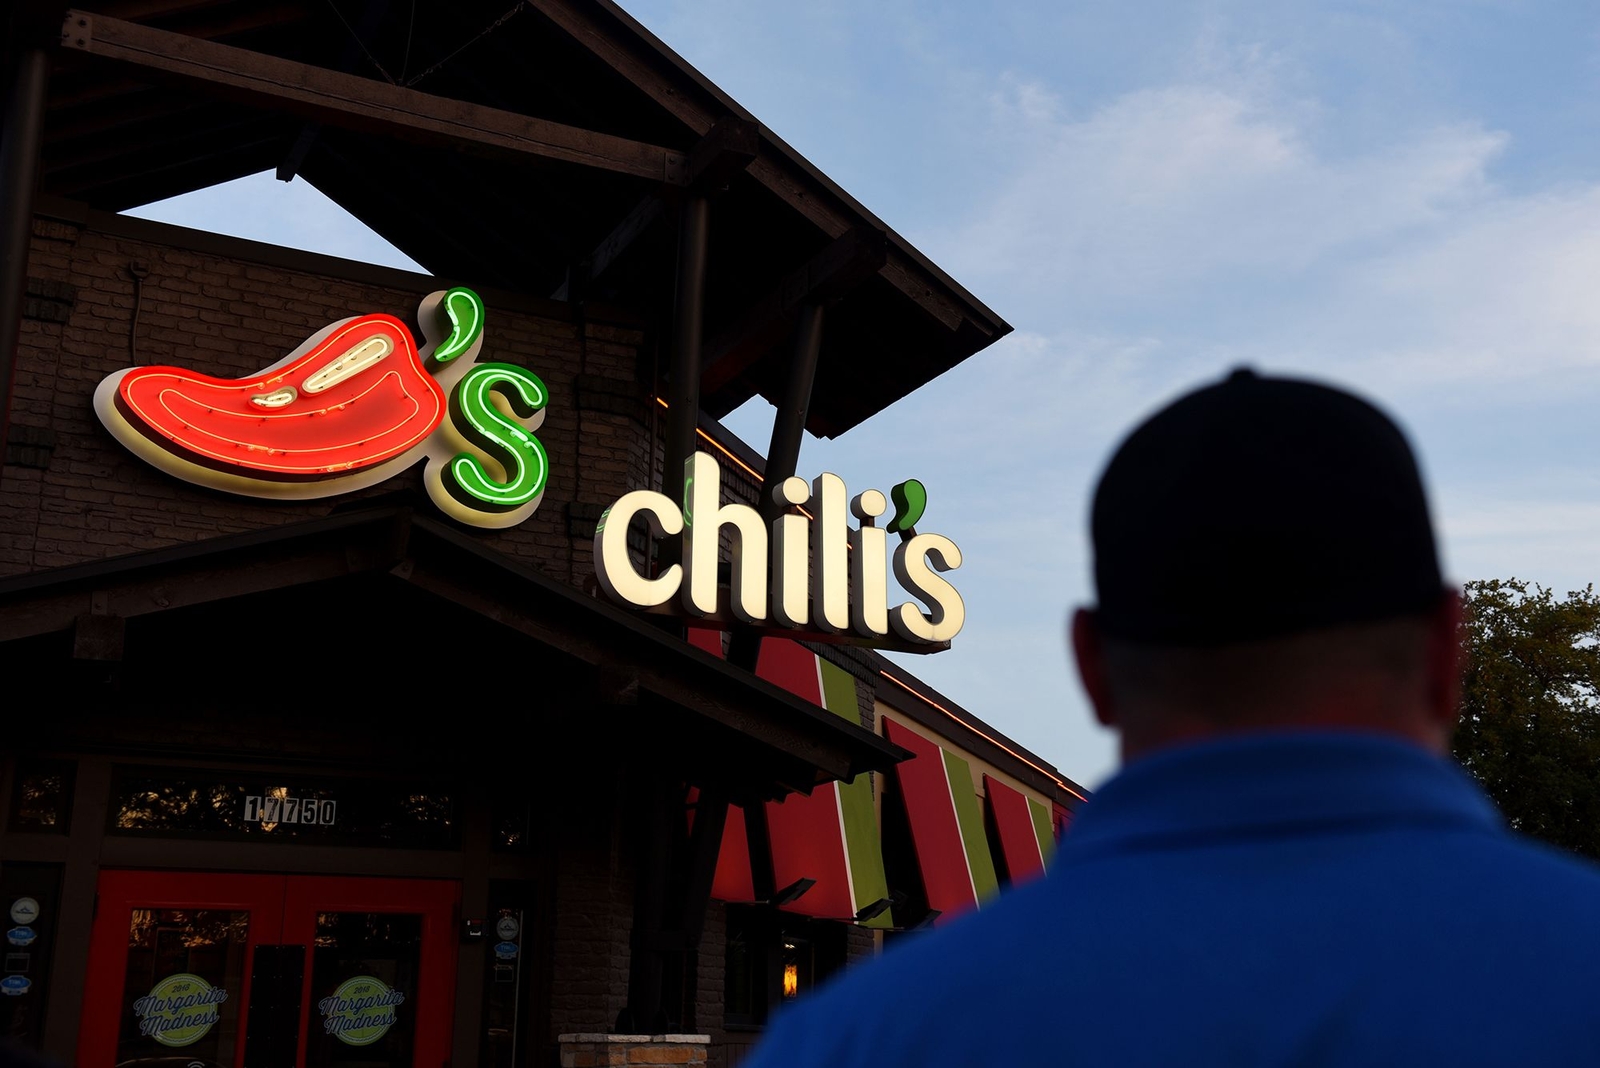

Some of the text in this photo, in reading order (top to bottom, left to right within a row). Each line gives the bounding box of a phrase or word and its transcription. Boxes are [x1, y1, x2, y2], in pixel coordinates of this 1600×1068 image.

[596, 451, 965, 643] chili's
[246, 797, 336, 824] 17750
[134, 986, 227, 1016] Margarita
[319, 988, 405, 1016] Margarita
[140, 1011, 219, 1037] Madness
[324, 1013, 397, 1036] Madness
